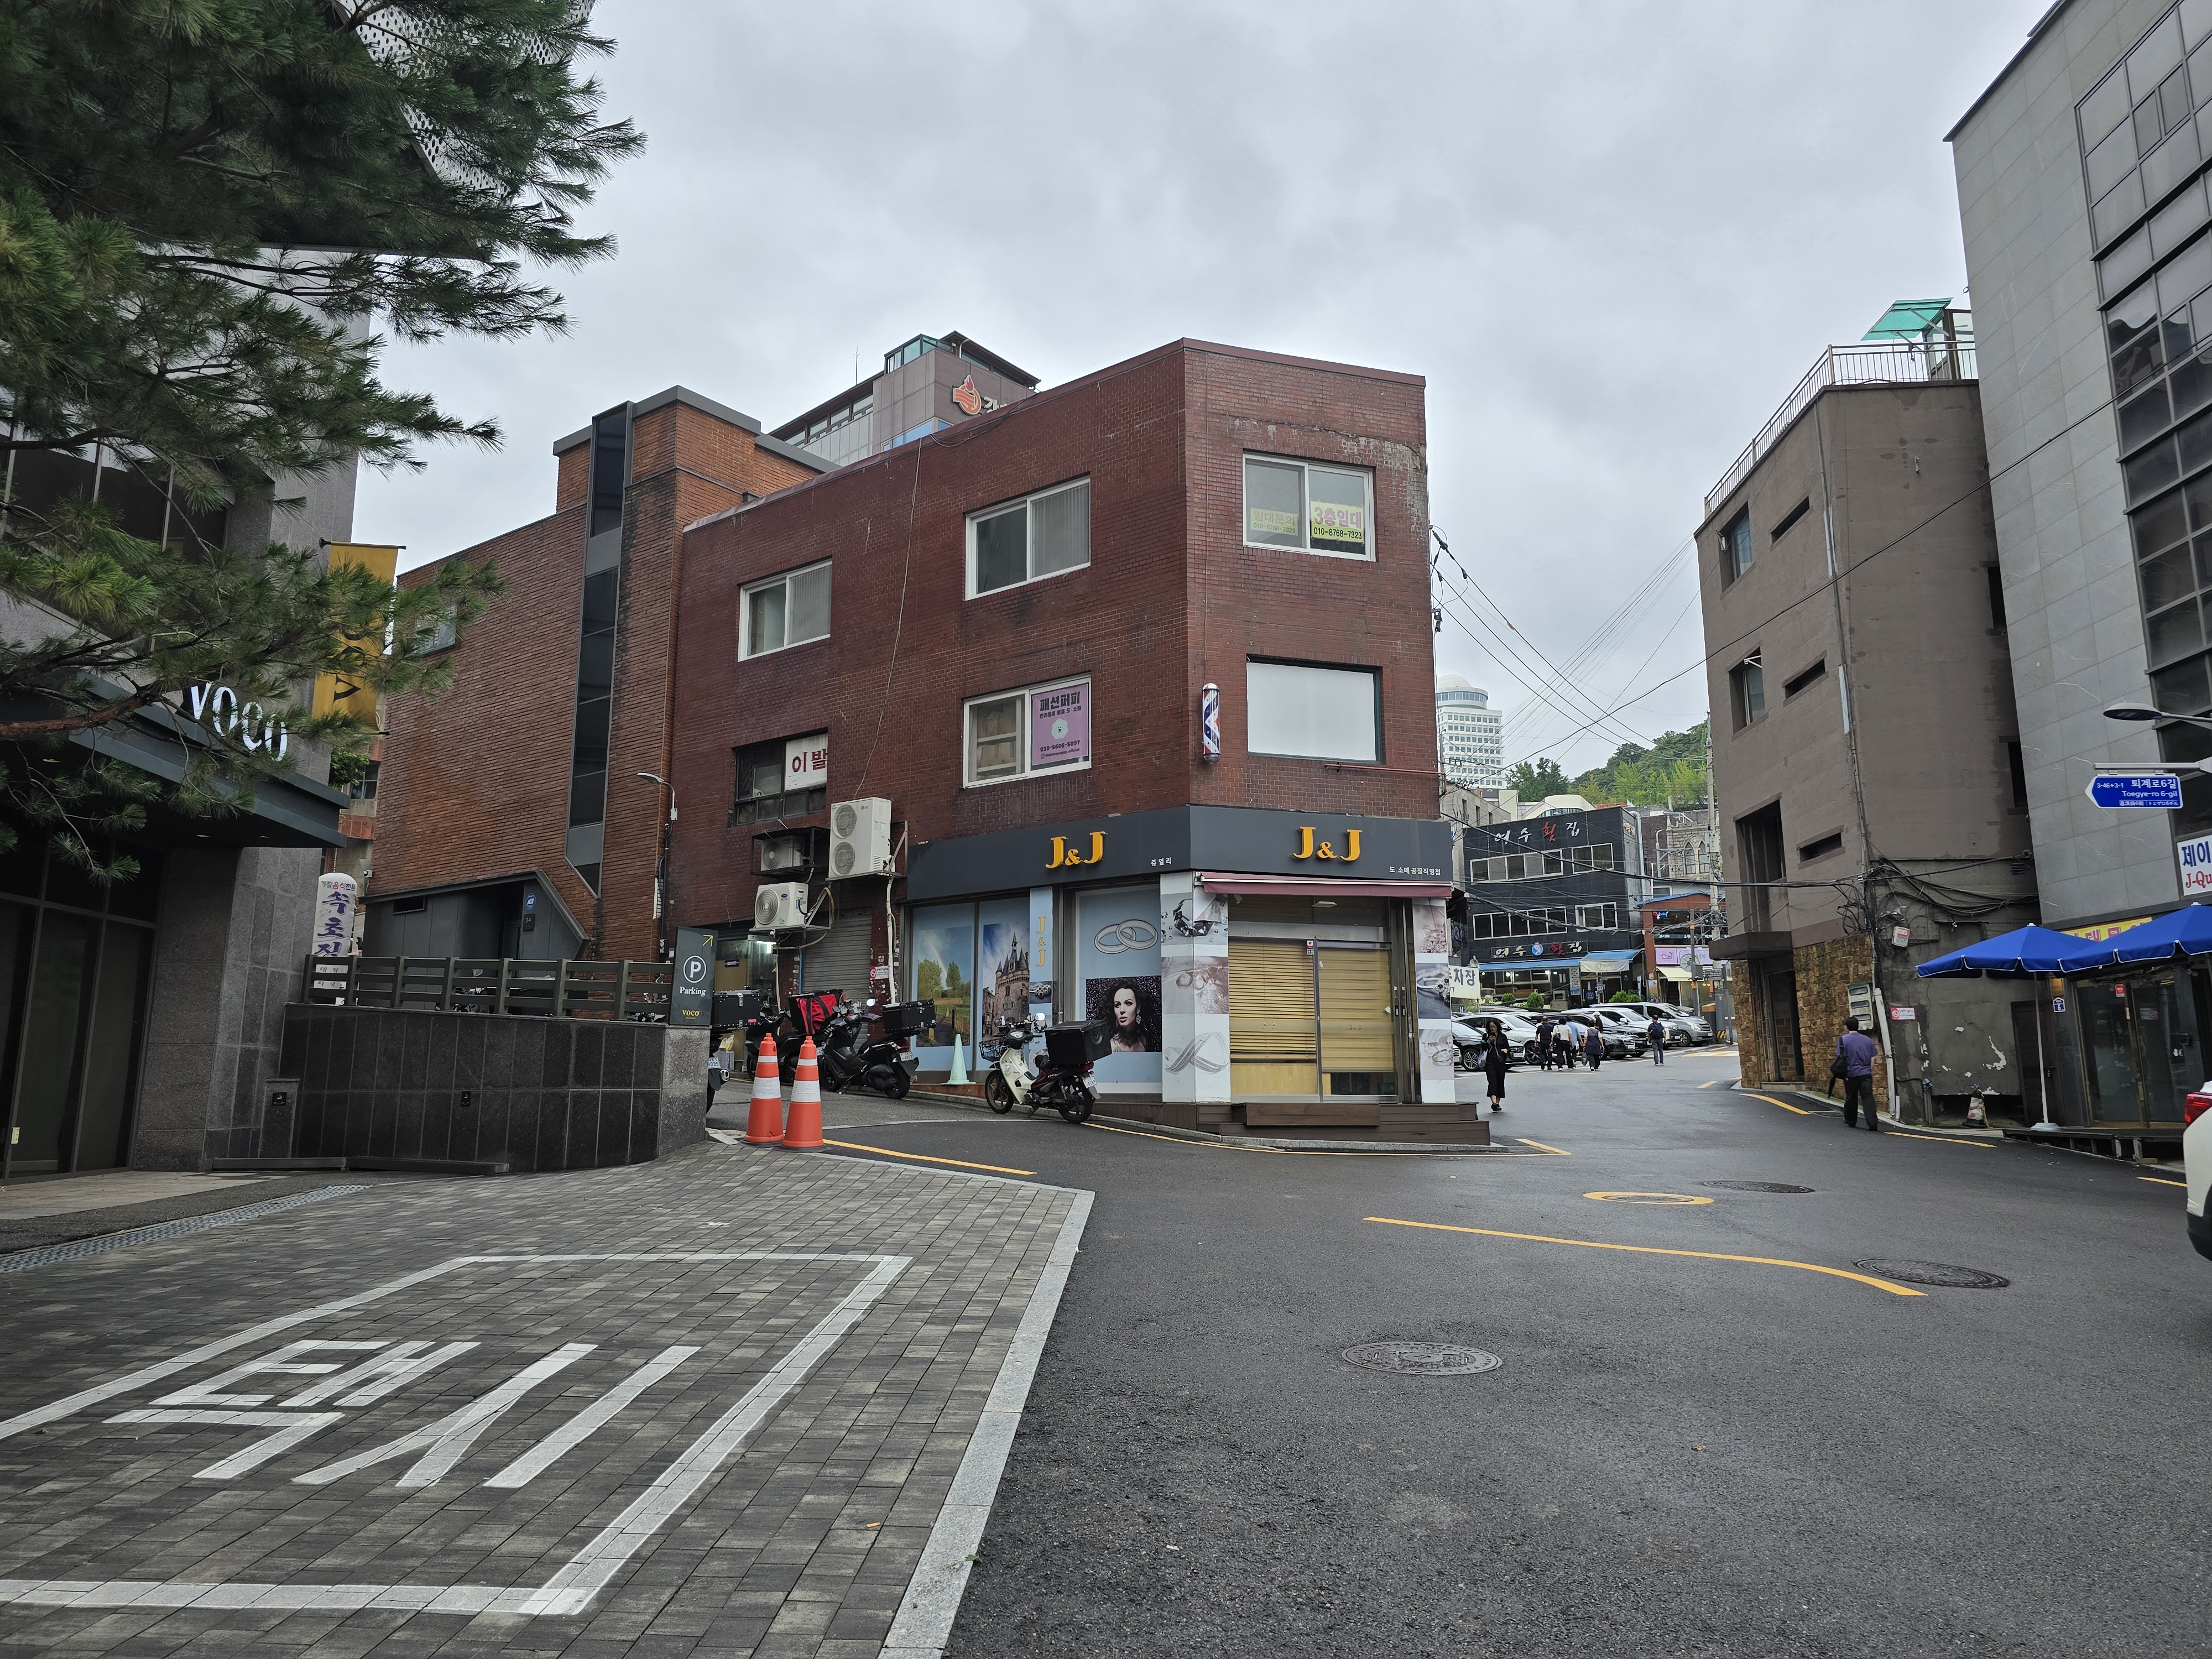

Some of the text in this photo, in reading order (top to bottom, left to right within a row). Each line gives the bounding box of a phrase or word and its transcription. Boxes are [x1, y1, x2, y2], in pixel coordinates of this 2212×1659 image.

[1253, 510, 1296, 526] 임대문의
[1314, 506, 1361, 529] 3층임대
[1253, 523, 1296, 534] 010-8768-7323
[1314, 526, 1362, 540] 010-8768-7323
[1040, 691, 1081, 712] 패션퍼피
[1040, 740, 1081, 752] 010-5606-5097
[2131, 779, 2177, 789] 퇴계로6길
[1045, 831, 1107, 869] J&J
[1291, 826, 1363, 861] J&J
[1151, 857, 1172, 867] 쥬얼리
[1411, 867, 1441, 876] 공장직영점
[680, 986, 707, 997] Parking
